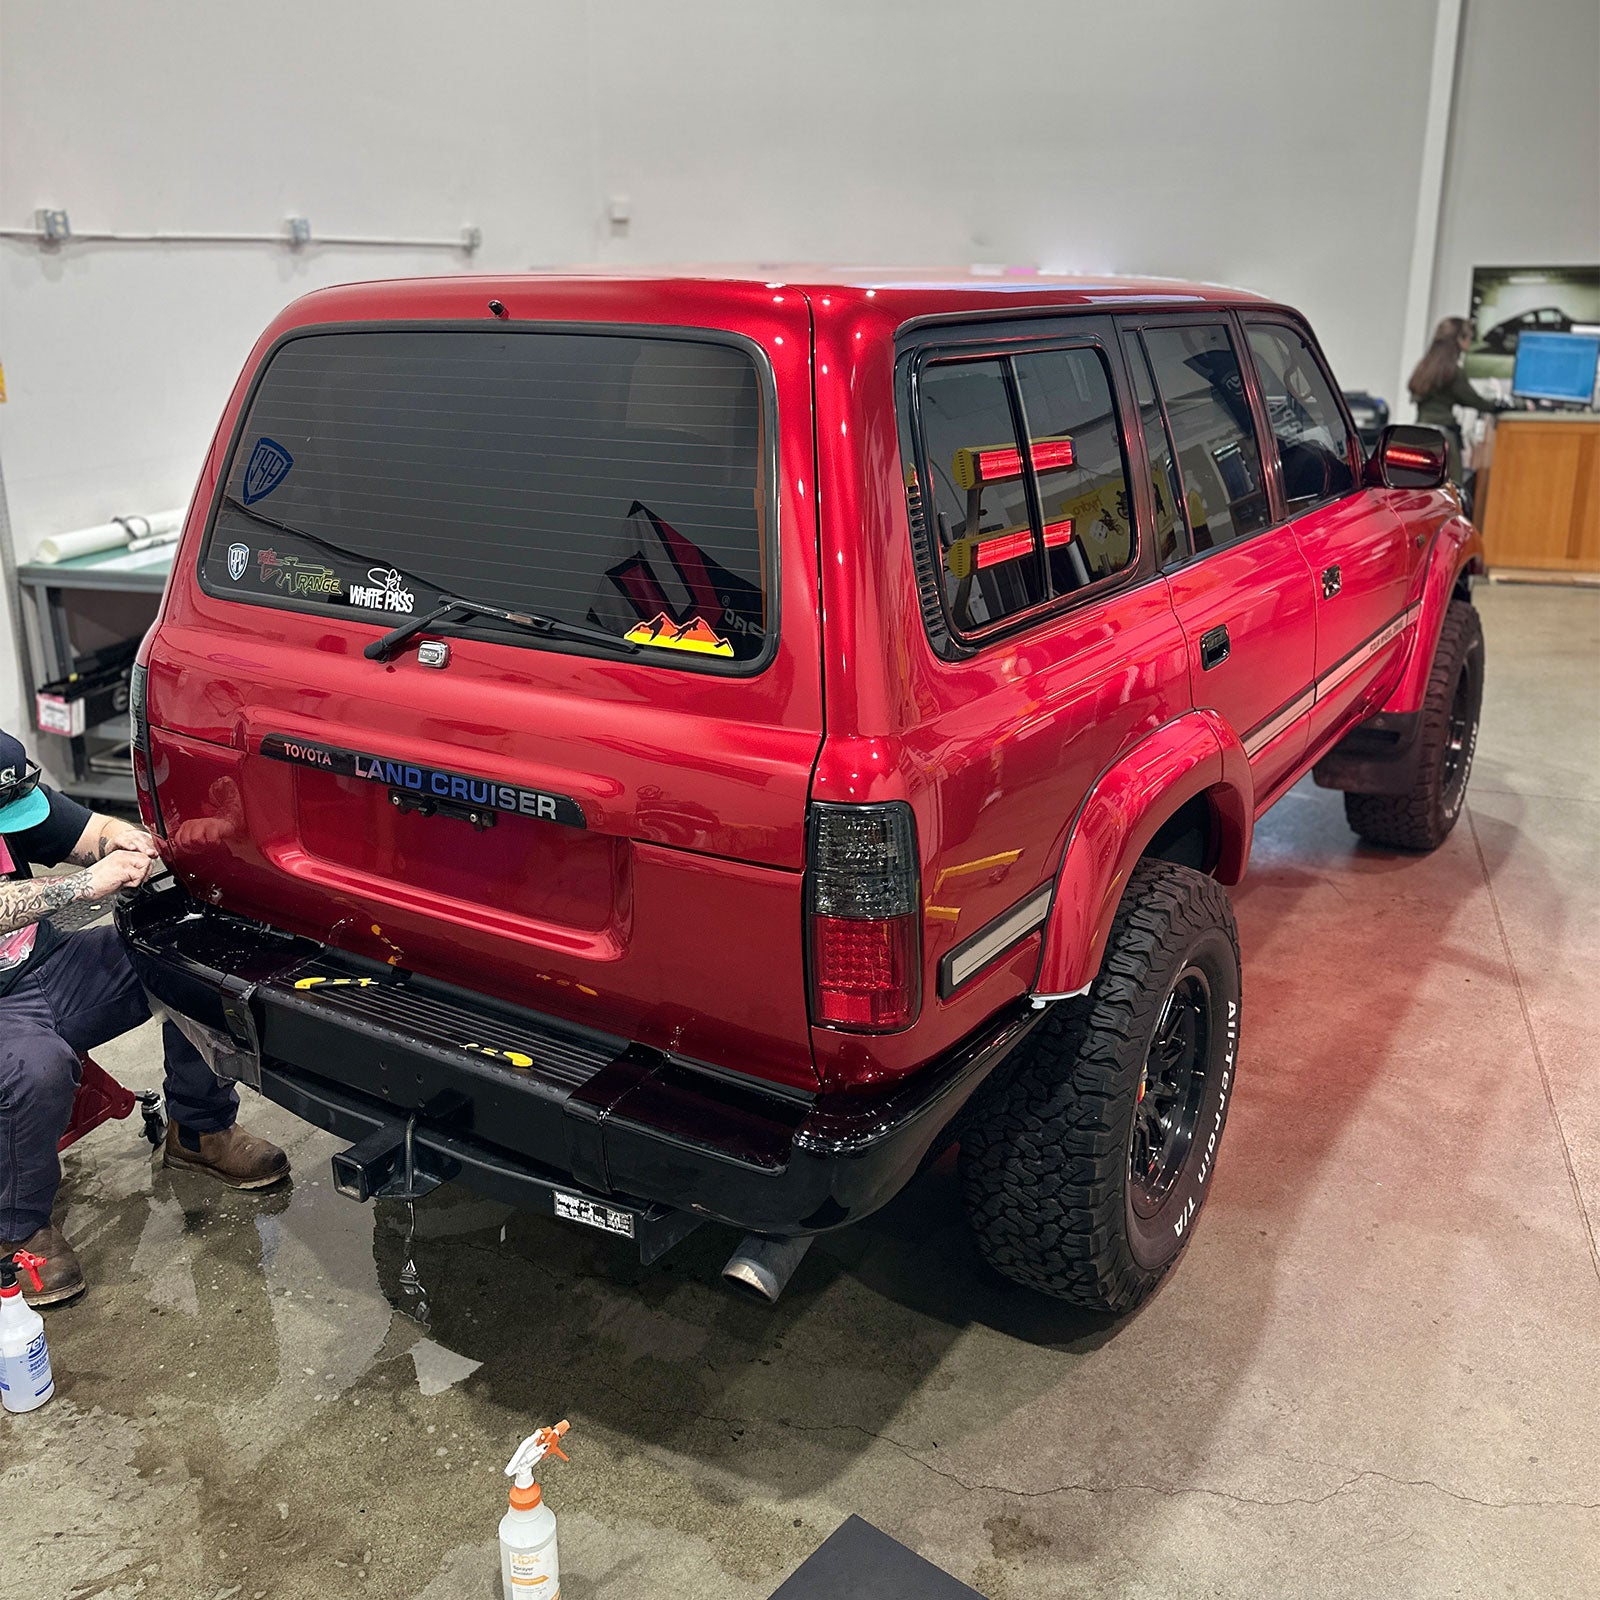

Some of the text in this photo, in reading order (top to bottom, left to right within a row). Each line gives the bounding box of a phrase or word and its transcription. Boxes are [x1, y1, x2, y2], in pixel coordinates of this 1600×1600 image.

[367, 567, 408, 596] Ski
[350, 585, 414, 613] WHITE PASS
[284, 743, 557, 820] TOYOTA LAND CRUISER
